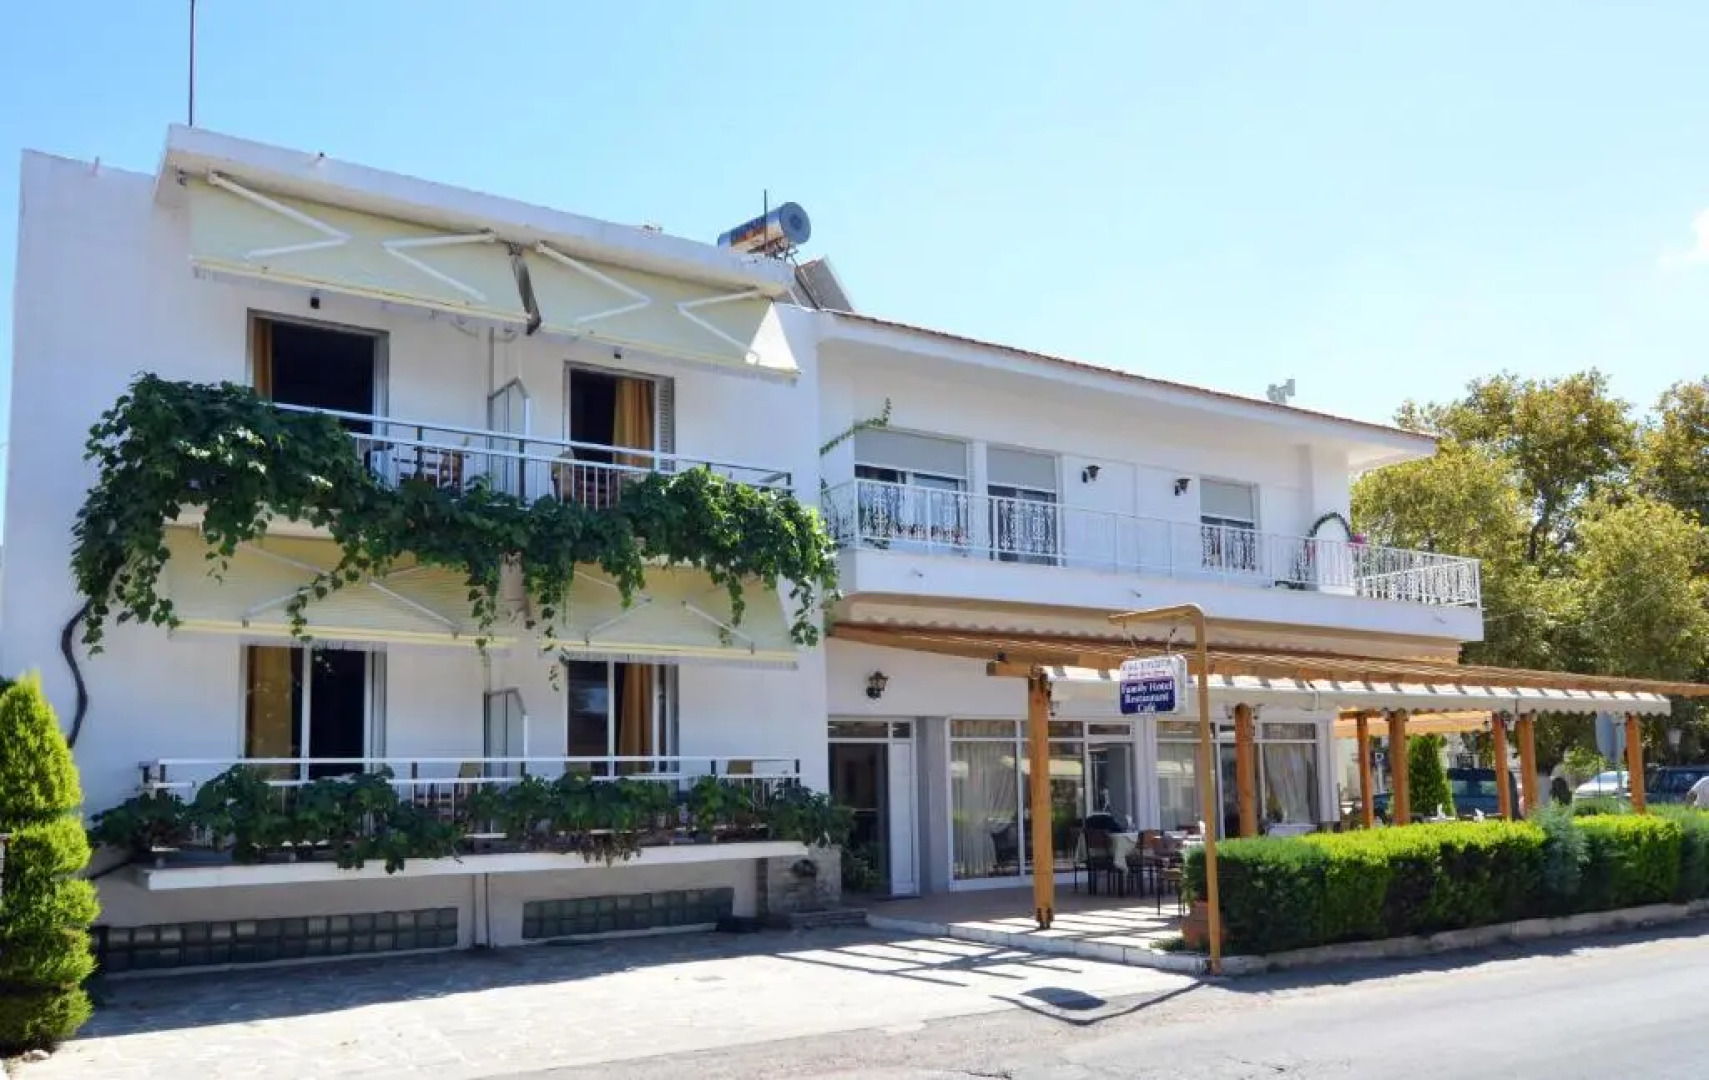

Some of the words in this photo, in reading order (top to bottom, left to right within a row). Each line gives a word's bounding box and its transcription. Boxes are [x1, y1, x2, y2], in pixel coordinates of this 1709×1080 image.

[1121, 682, 1147, 694] Family
[1149, 680, 1173, 691] Hotel
[1124, 692, 1169, 704] Restaurant
